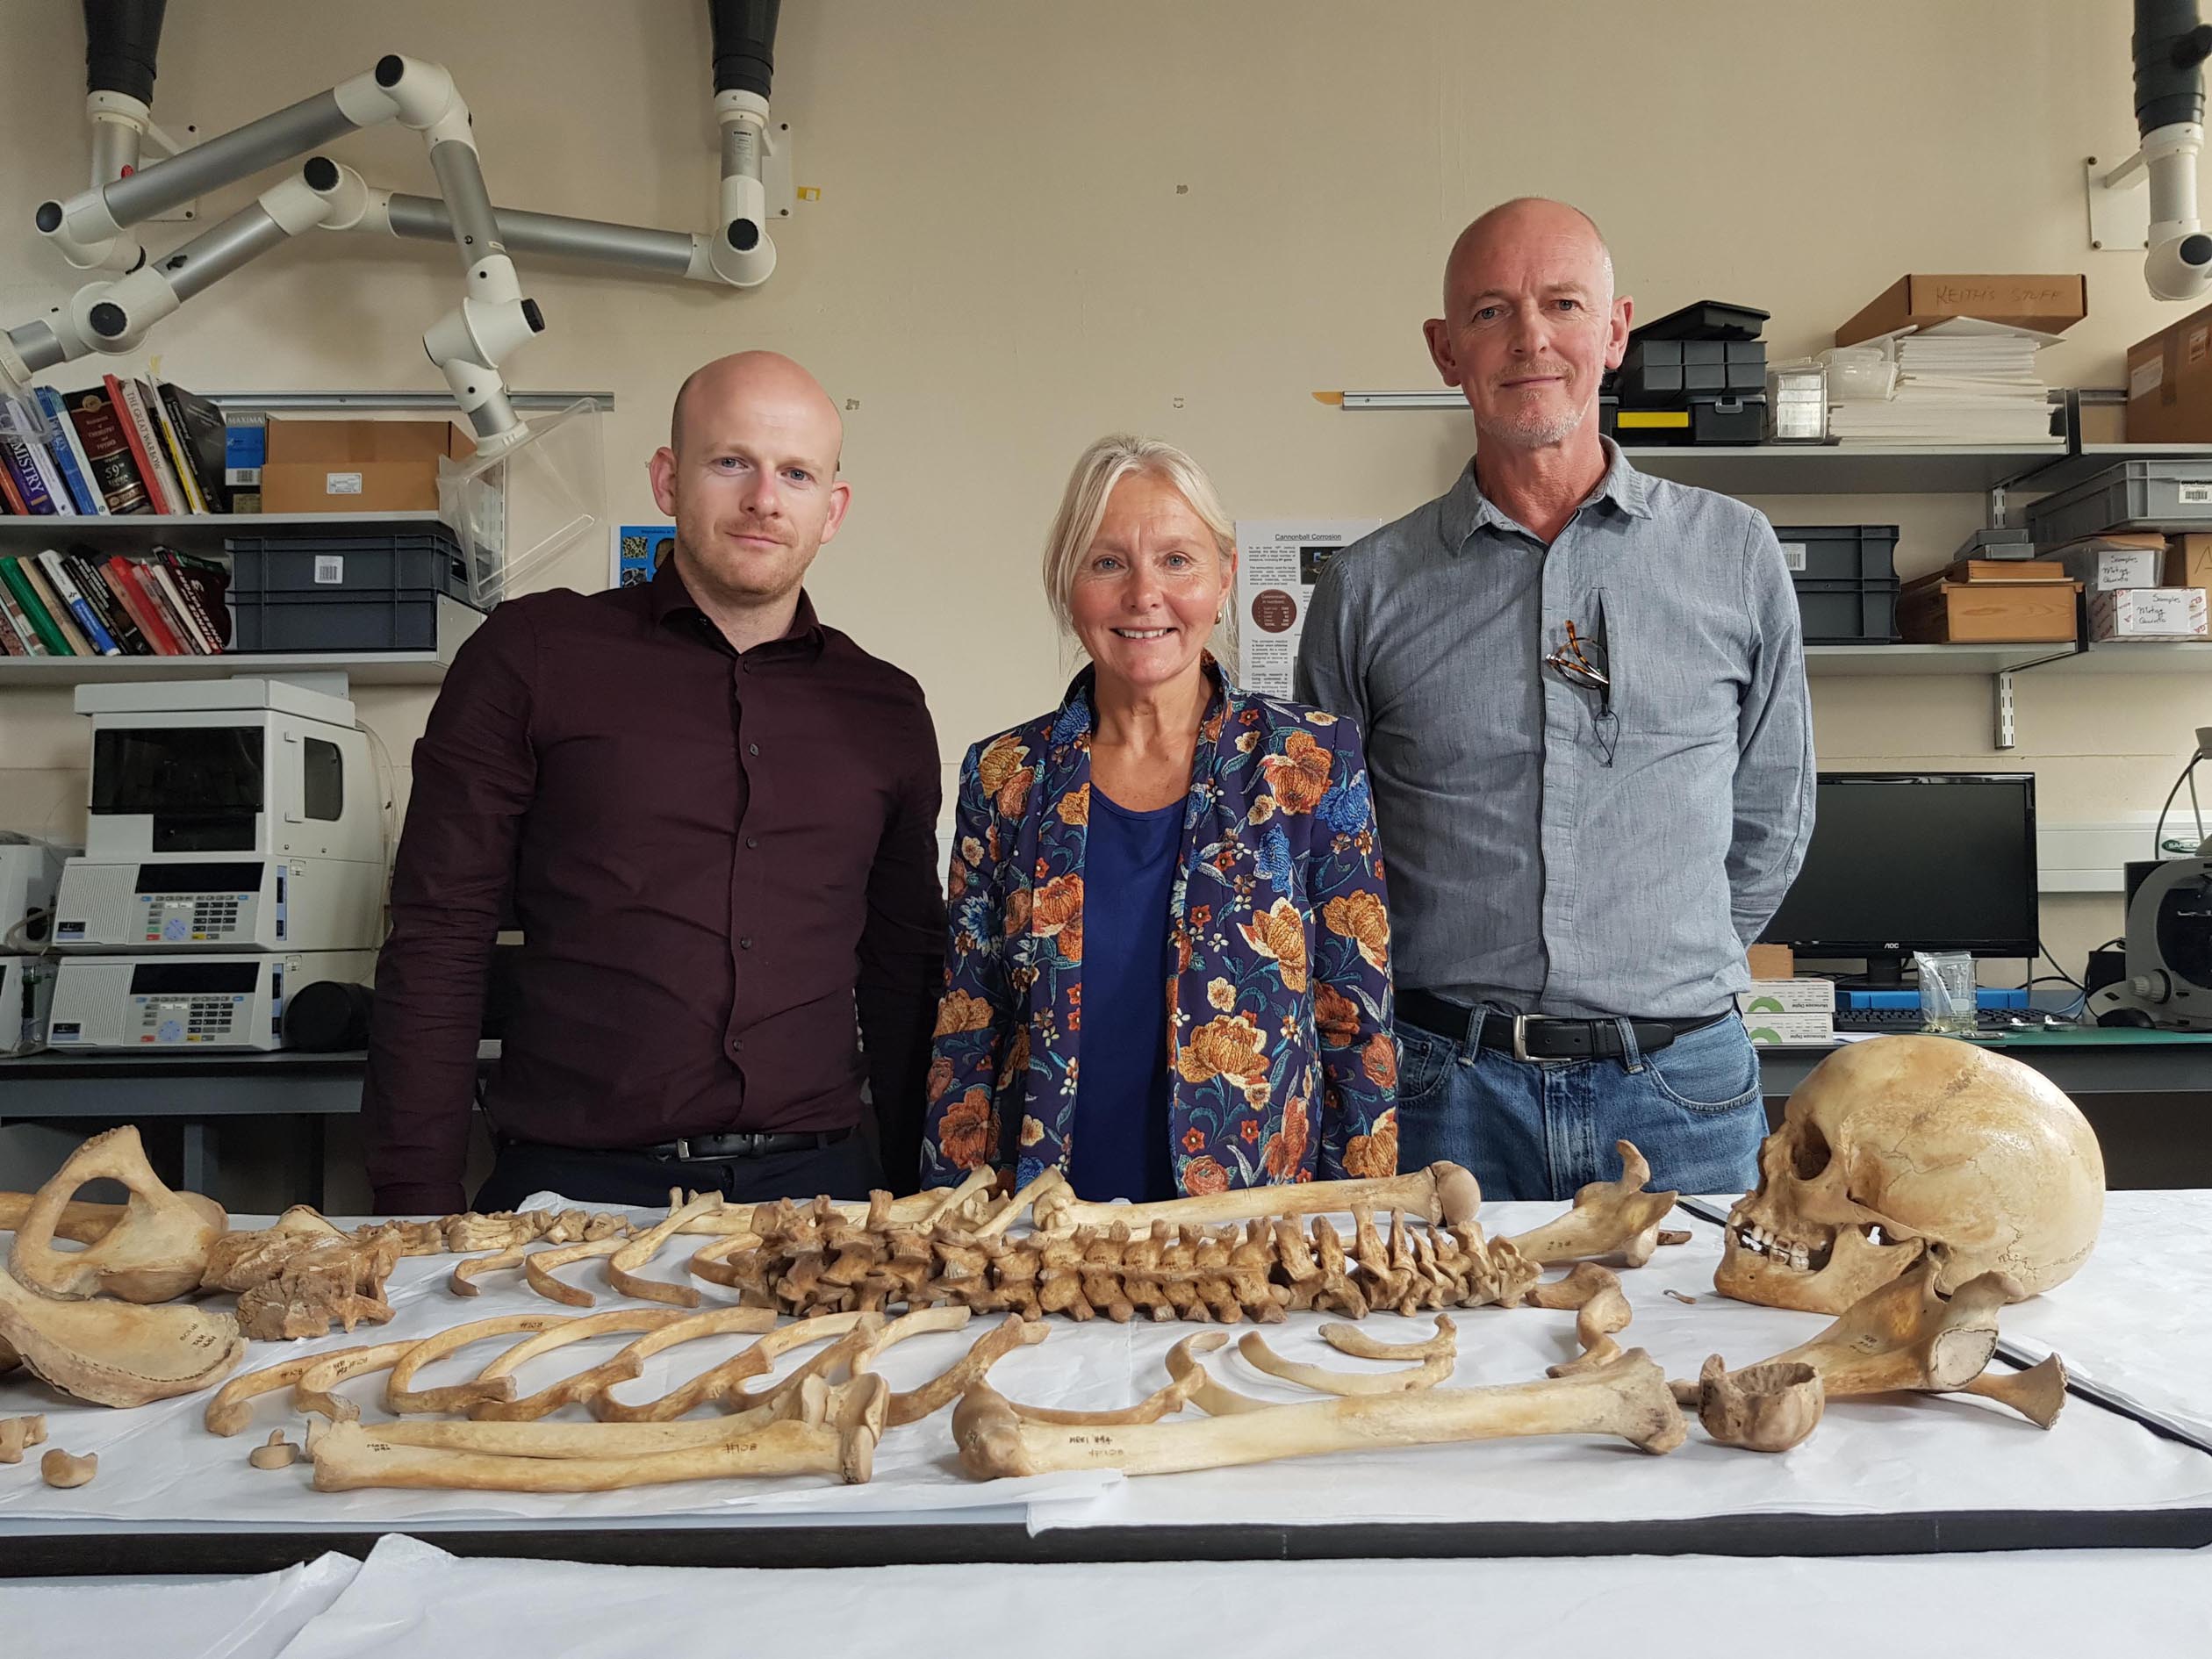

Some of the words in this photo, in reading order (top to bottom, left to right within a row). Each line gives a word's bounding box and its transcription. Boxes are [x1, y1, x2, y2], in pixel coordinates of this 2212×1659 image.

[126, 391, 139, 407] THE
[132, 407, 148, 434] GREAT
[141, 433, 162, 470] WARBOW
[186, 602, 220, 650] SCIENCE
